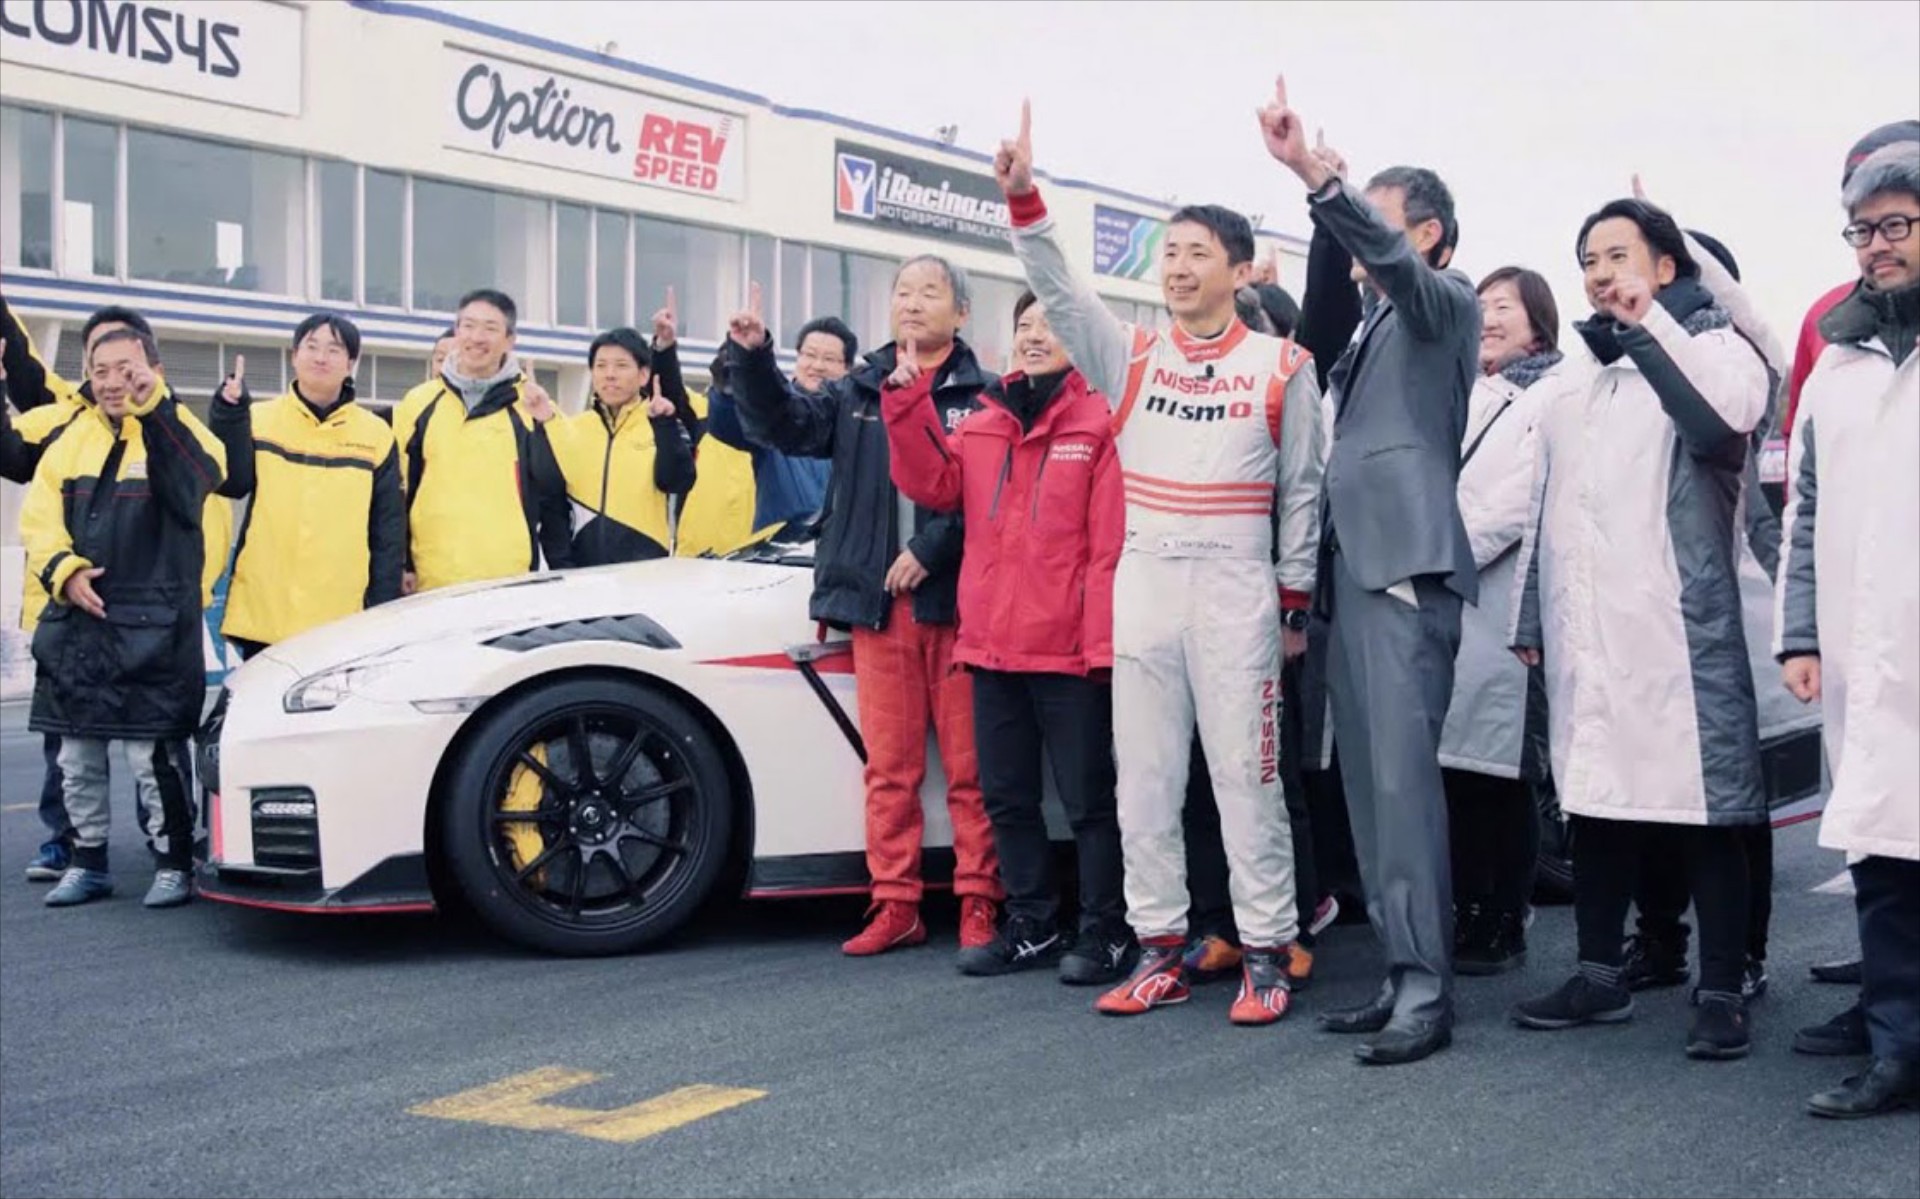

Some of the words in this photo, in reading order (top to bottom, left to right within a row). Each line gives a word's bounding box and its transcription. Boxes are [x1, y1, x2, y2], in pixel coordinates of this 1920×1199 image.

[457, 63, 621, 153] Option
[638, 112, 727, 165] REV
[633, 153, 718, 191] SPEED
[877, 166, 1010, 228] iRacing.co
[877, 204, 955, 230] MOTORSPORT
[955, 219, 1011, 241] SIMULATIO
[1152, 368, 1255, 395] NISSAN
[1261, 680, 1275, 784] NISSAN
